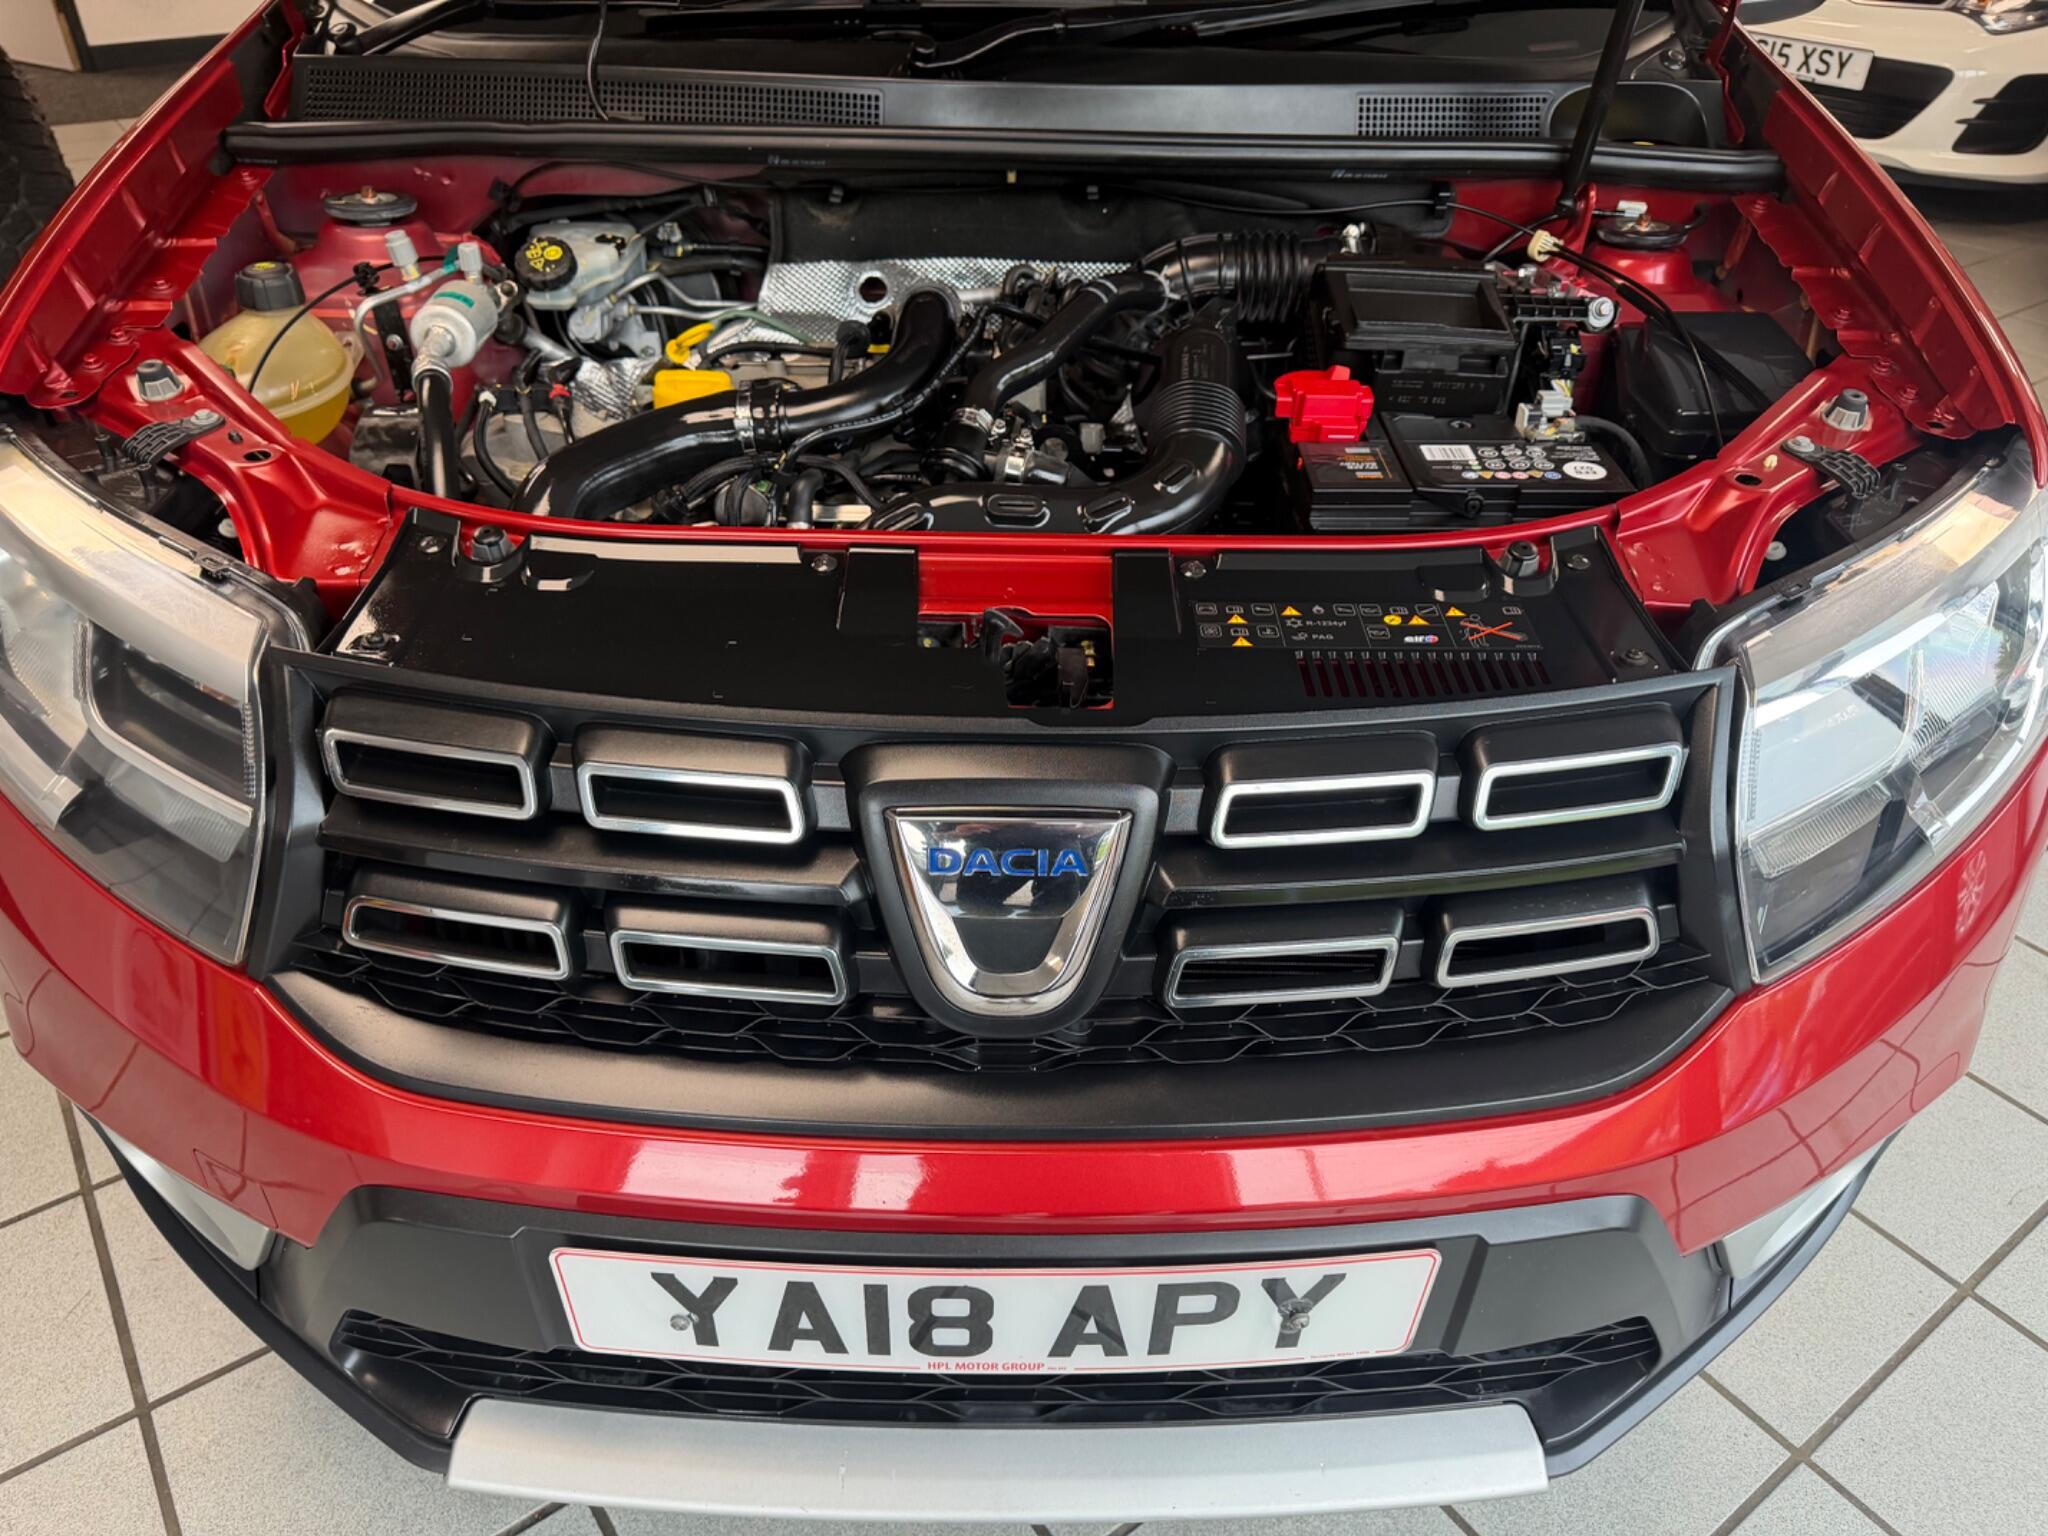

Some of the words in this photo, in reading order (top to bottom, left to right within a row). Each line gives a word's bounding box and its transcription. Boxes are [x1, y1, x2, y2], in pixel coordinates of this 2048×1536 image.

[1797, 46, 1853, 79] XSY
[928, 847, 1088, 877] DACIA
[651, 1272, 994, 1357] YA18
[1047, 1273, 1347, 1357] APY
[927, 1361, 950, 1370] HPL
[955, 1361, 999, 1370] MOTOR
[1002, 1361, 1045, 1371] GROUP
